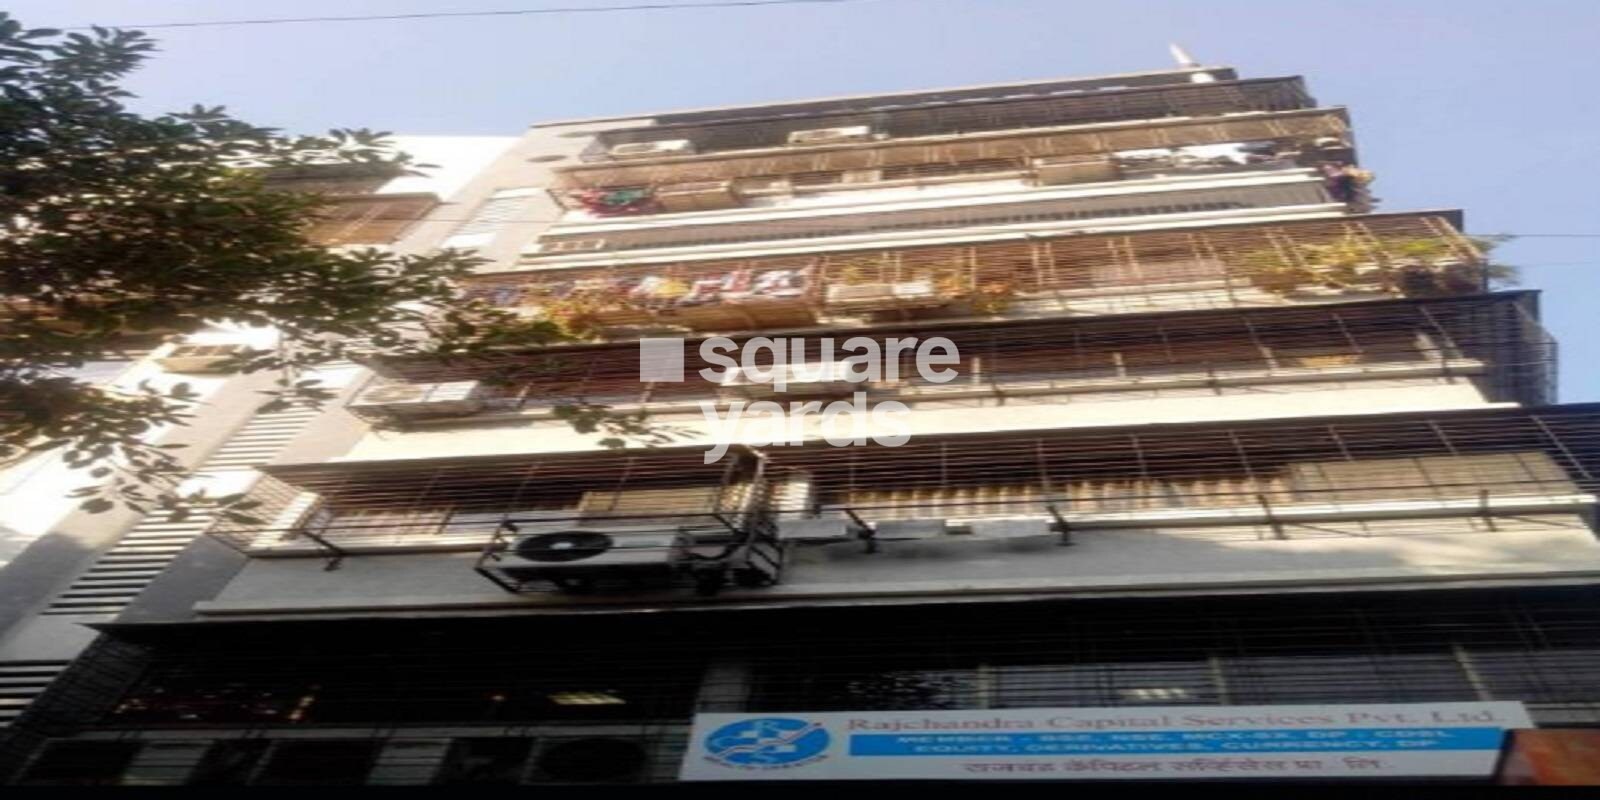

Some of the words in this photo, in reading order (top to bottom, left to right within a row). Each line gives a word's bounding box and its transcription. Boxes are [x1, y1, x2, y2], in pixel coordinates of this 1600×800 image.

[847, 718, 1034, 731] Rajchandra
[1048, 715, 1169, 729] Capital
[1183, 715, 1333, 726] Services
